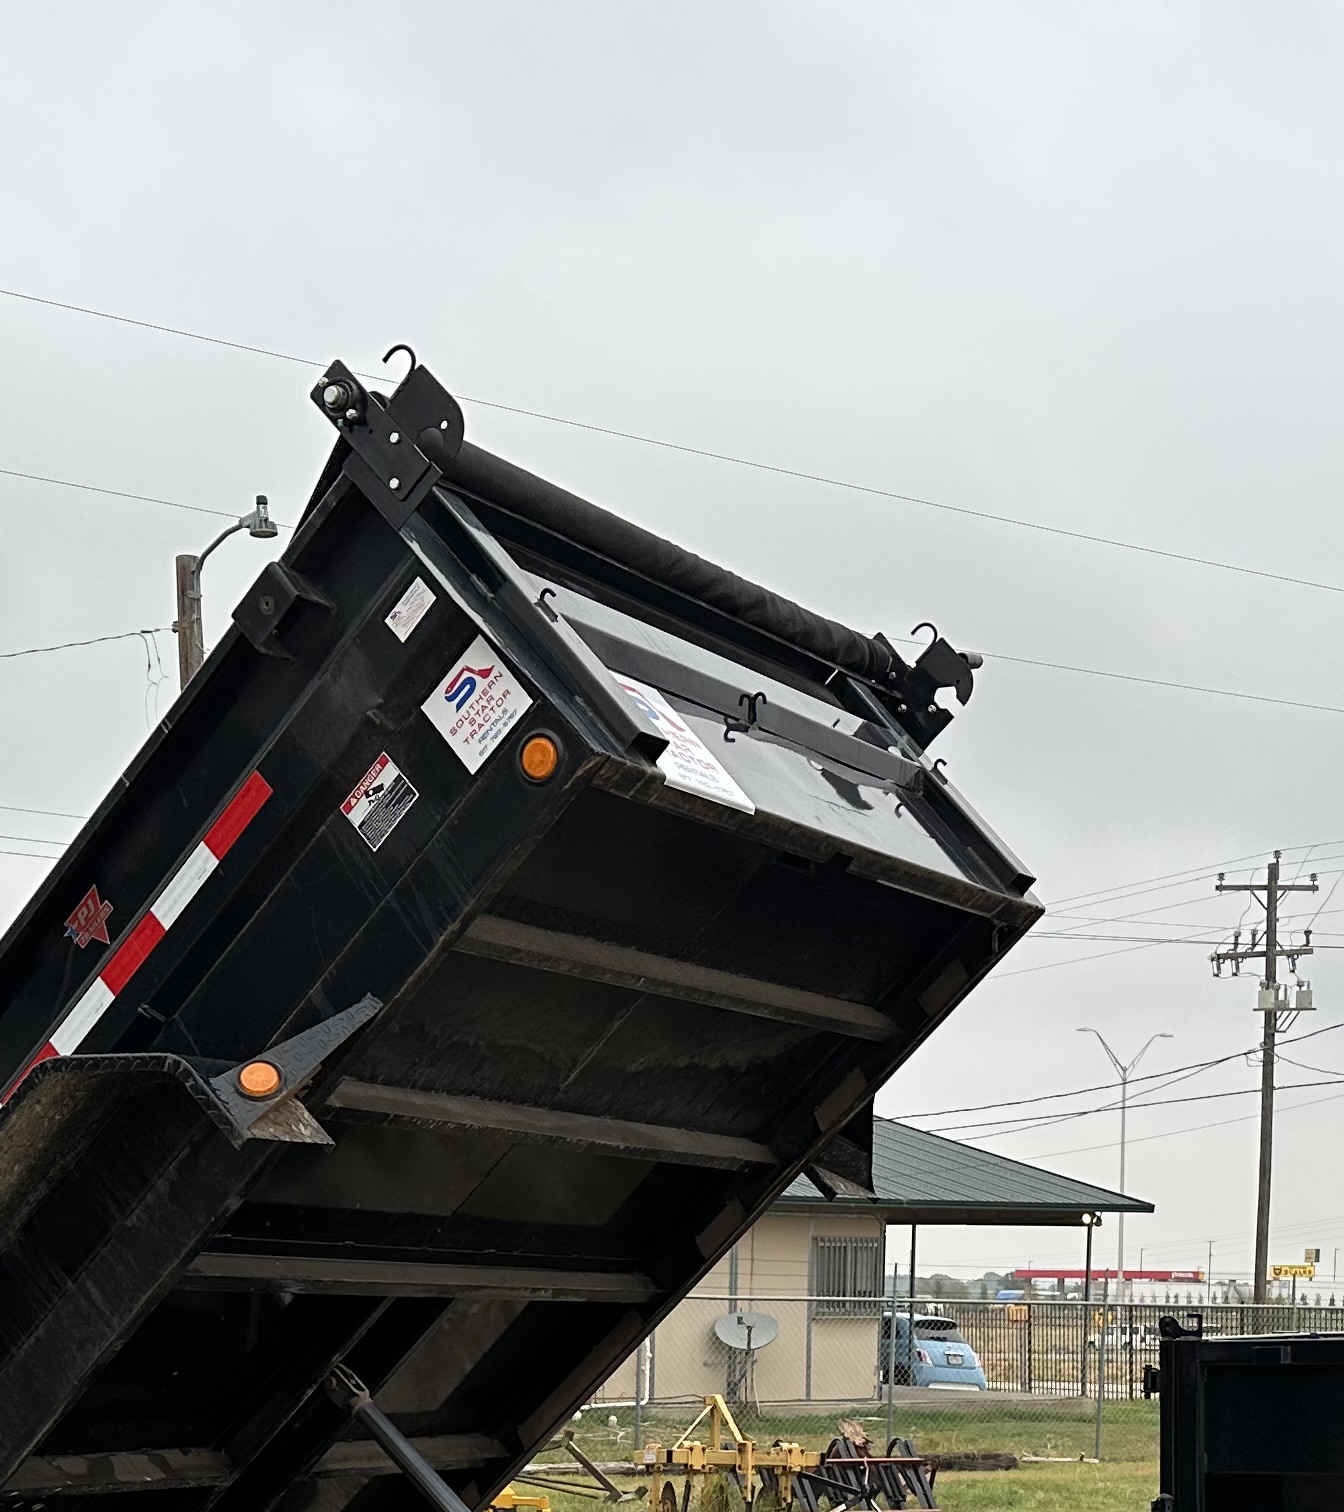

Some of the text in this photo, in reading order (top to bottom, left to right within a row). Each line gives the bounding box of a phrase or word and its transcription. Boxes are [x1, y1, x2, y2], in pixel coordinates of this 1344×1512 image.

[450, 670, 503, 737] SOUTHERN
[463, 689, 511, 745] TRACTOR
[468, 694, 495, 727] STAR
[478, 707, 509, 745] RENTALS
[355, 763, 383, 800] DANGER
[77, 898, 95, 926] PJ
[80, 904, 110, 943] TRAILERS
